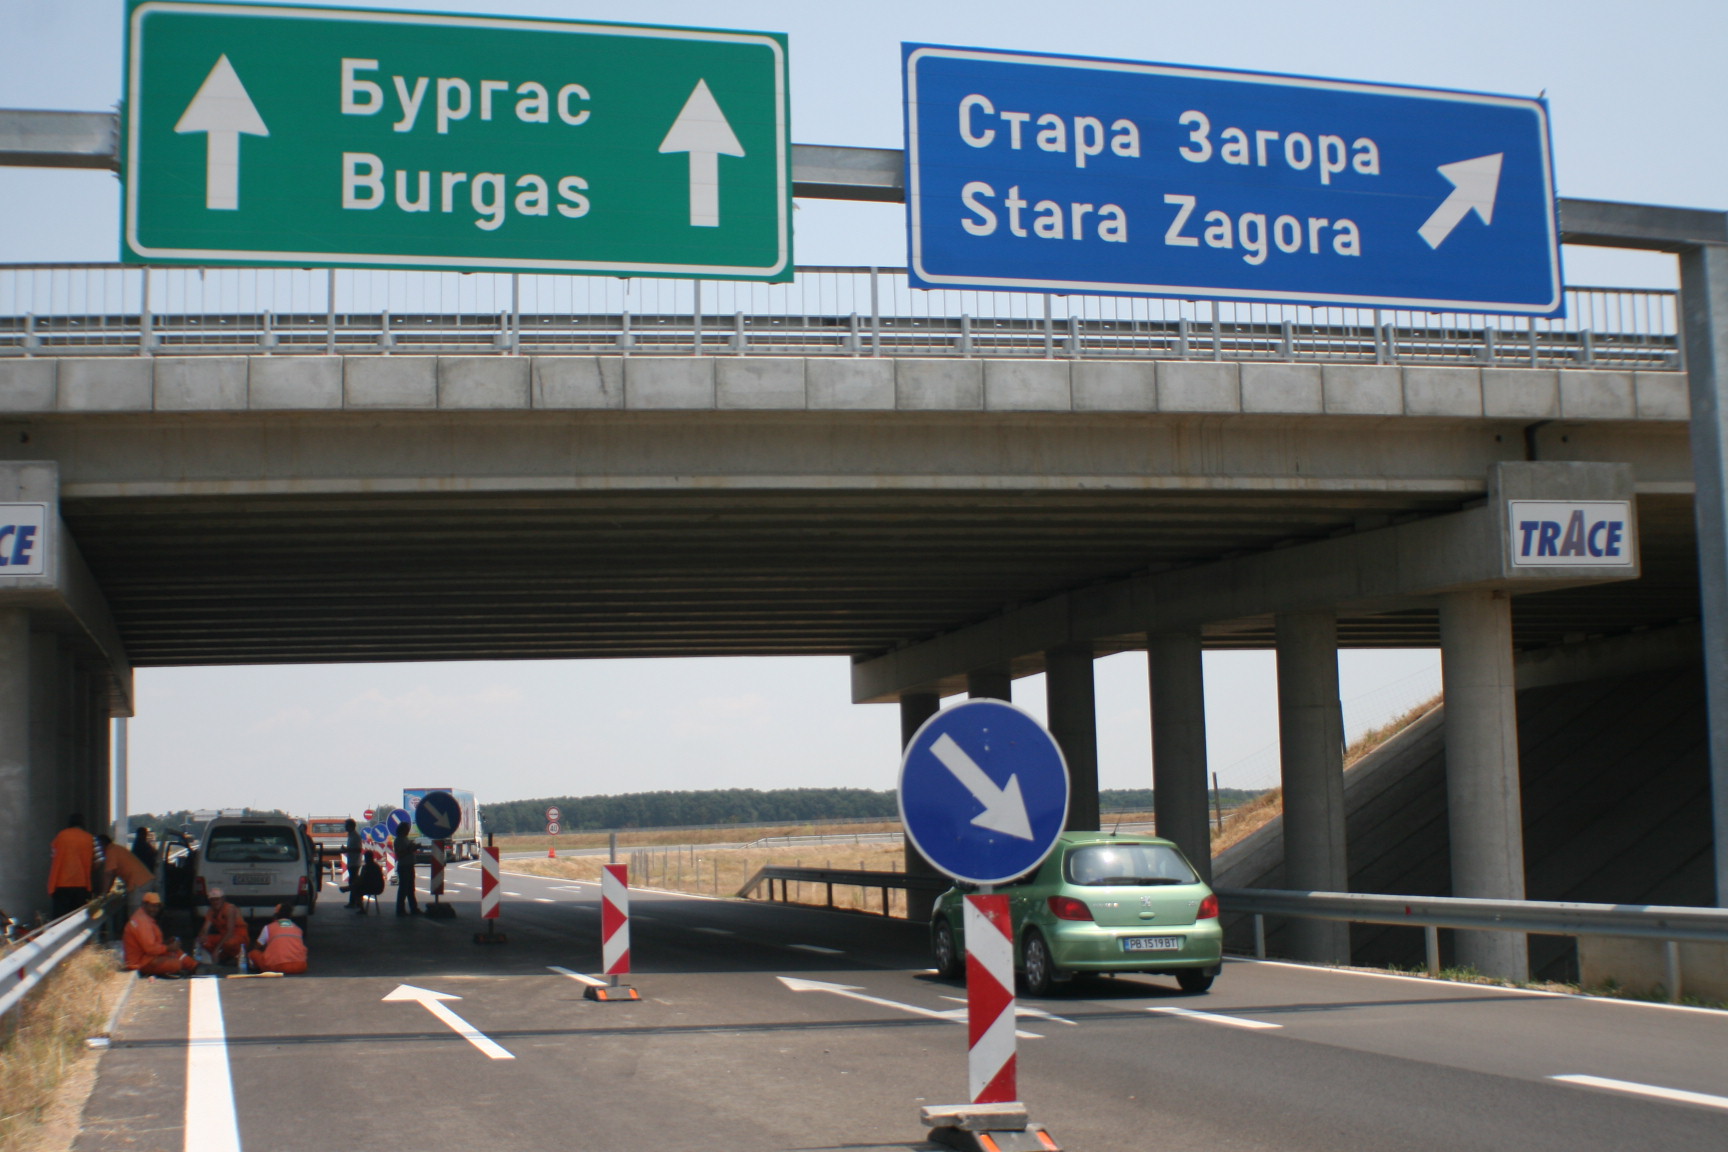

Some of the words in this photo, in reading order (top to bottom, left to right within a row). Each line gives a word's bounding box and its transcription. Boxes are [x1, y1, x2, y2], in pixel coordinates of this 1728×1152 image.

[340, 57, 592, 135] Бургас
[958, 92, 1141, 169] Стара
[1178, 109, 1381, 185] Загора
[341, 152, 591, 231] Burgas
[961, 180, 1129, 244] Stara
[1164, 193, 1362, 266] Zagora
[1519, 509, 1623, 557] TRACE
